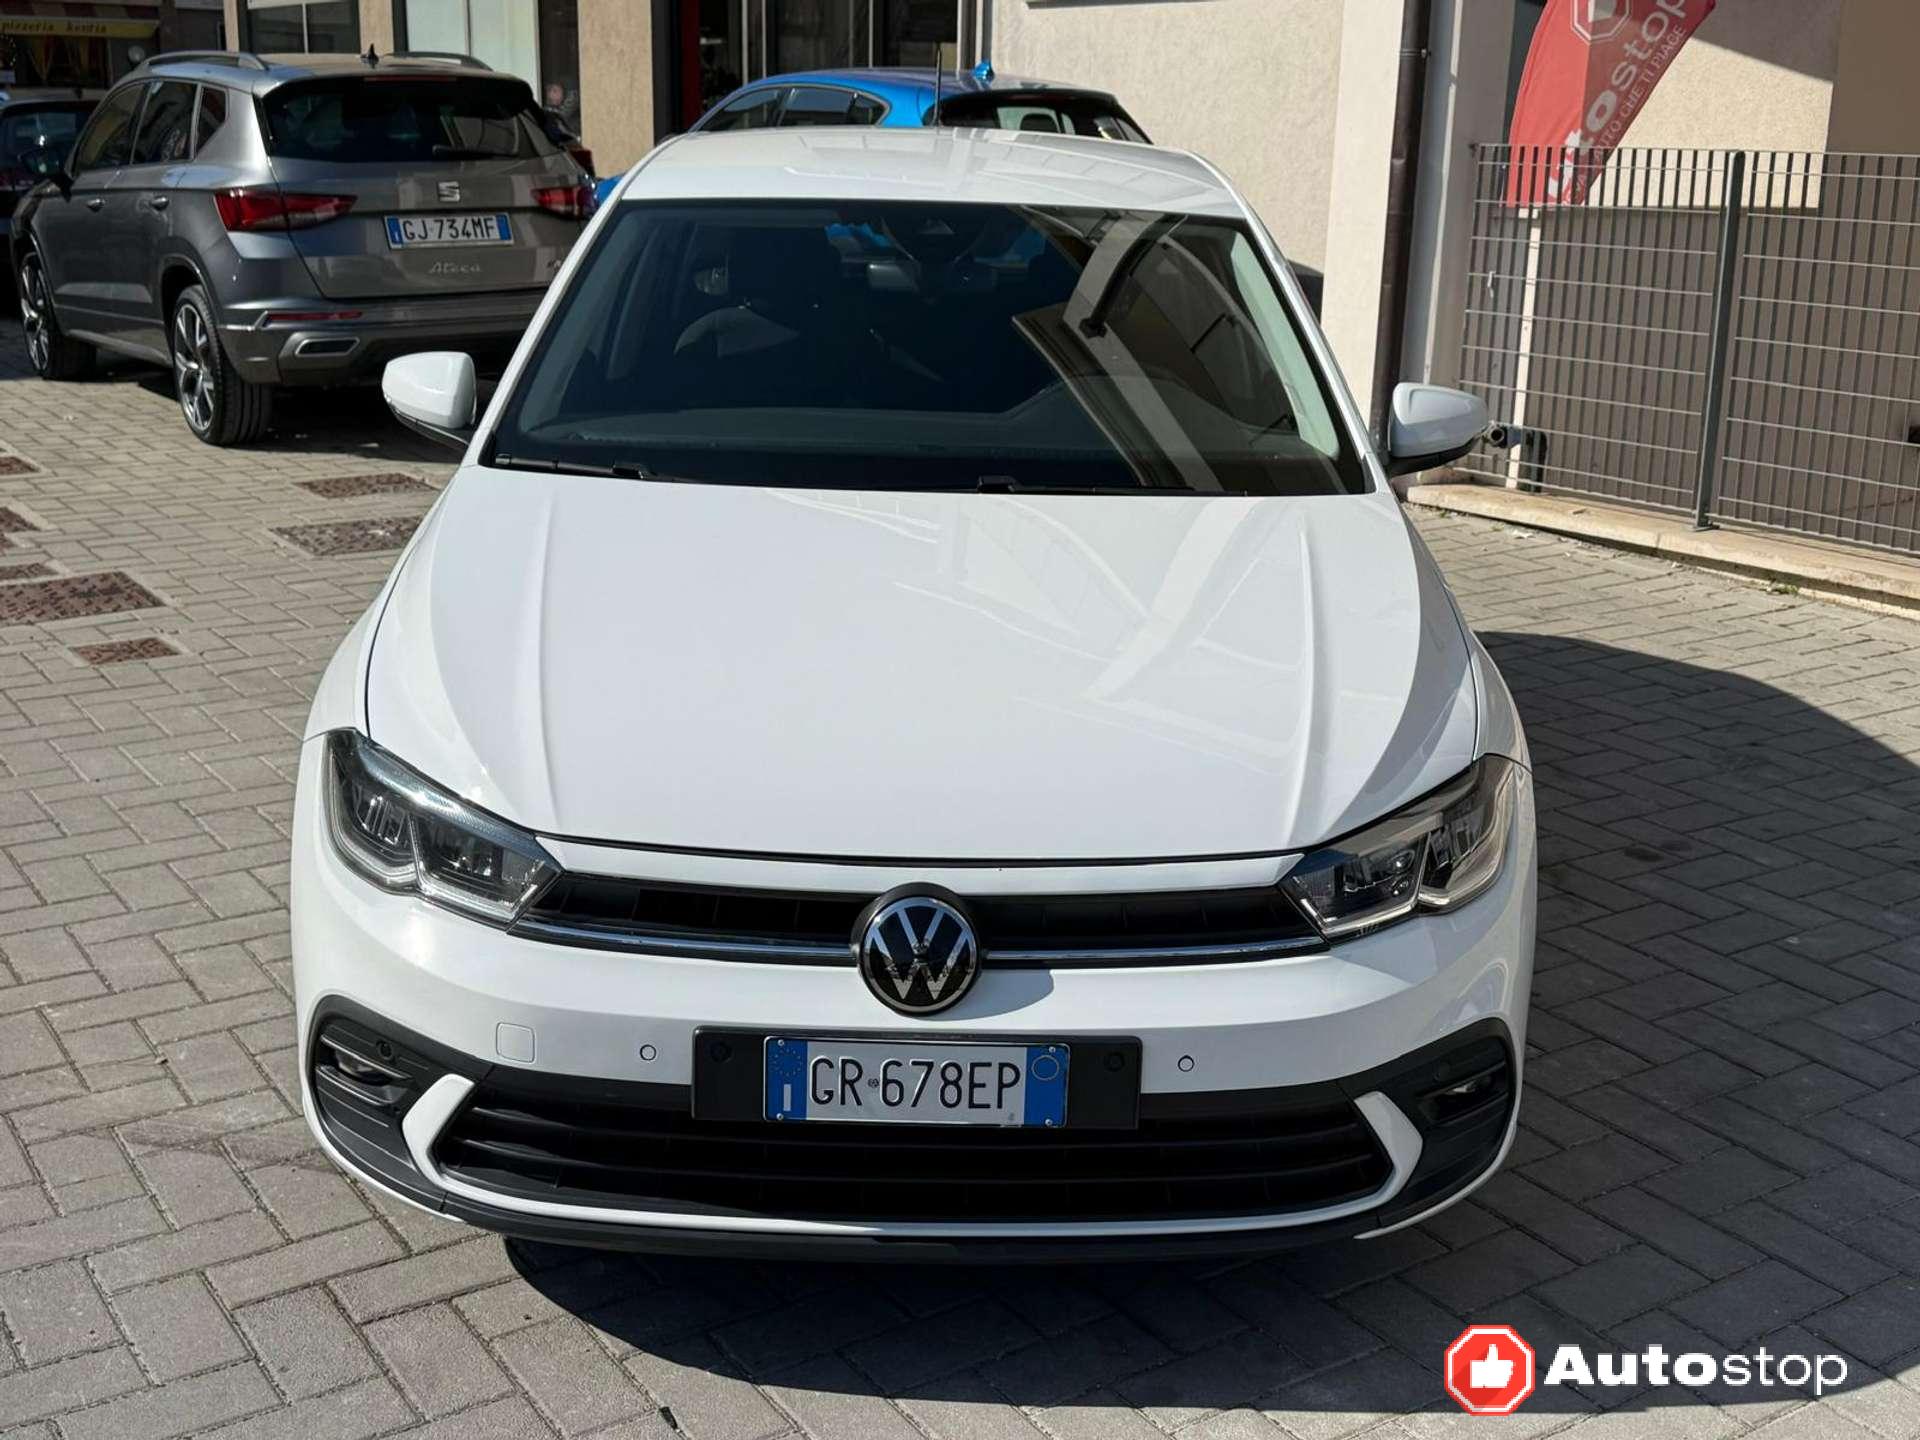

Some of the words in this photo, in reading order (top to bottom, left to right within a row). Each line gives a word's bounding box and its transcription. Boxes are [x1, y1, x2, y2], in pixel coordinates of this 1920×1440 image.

[1650, 25, 1686, 69] PIACE
[402, 219, 429, 241] GJ
[432, 216, 495, 240] 734MF
[810, 1055, 864, 1106] GR
[880, 1058, 1021, 1110] 678EP
